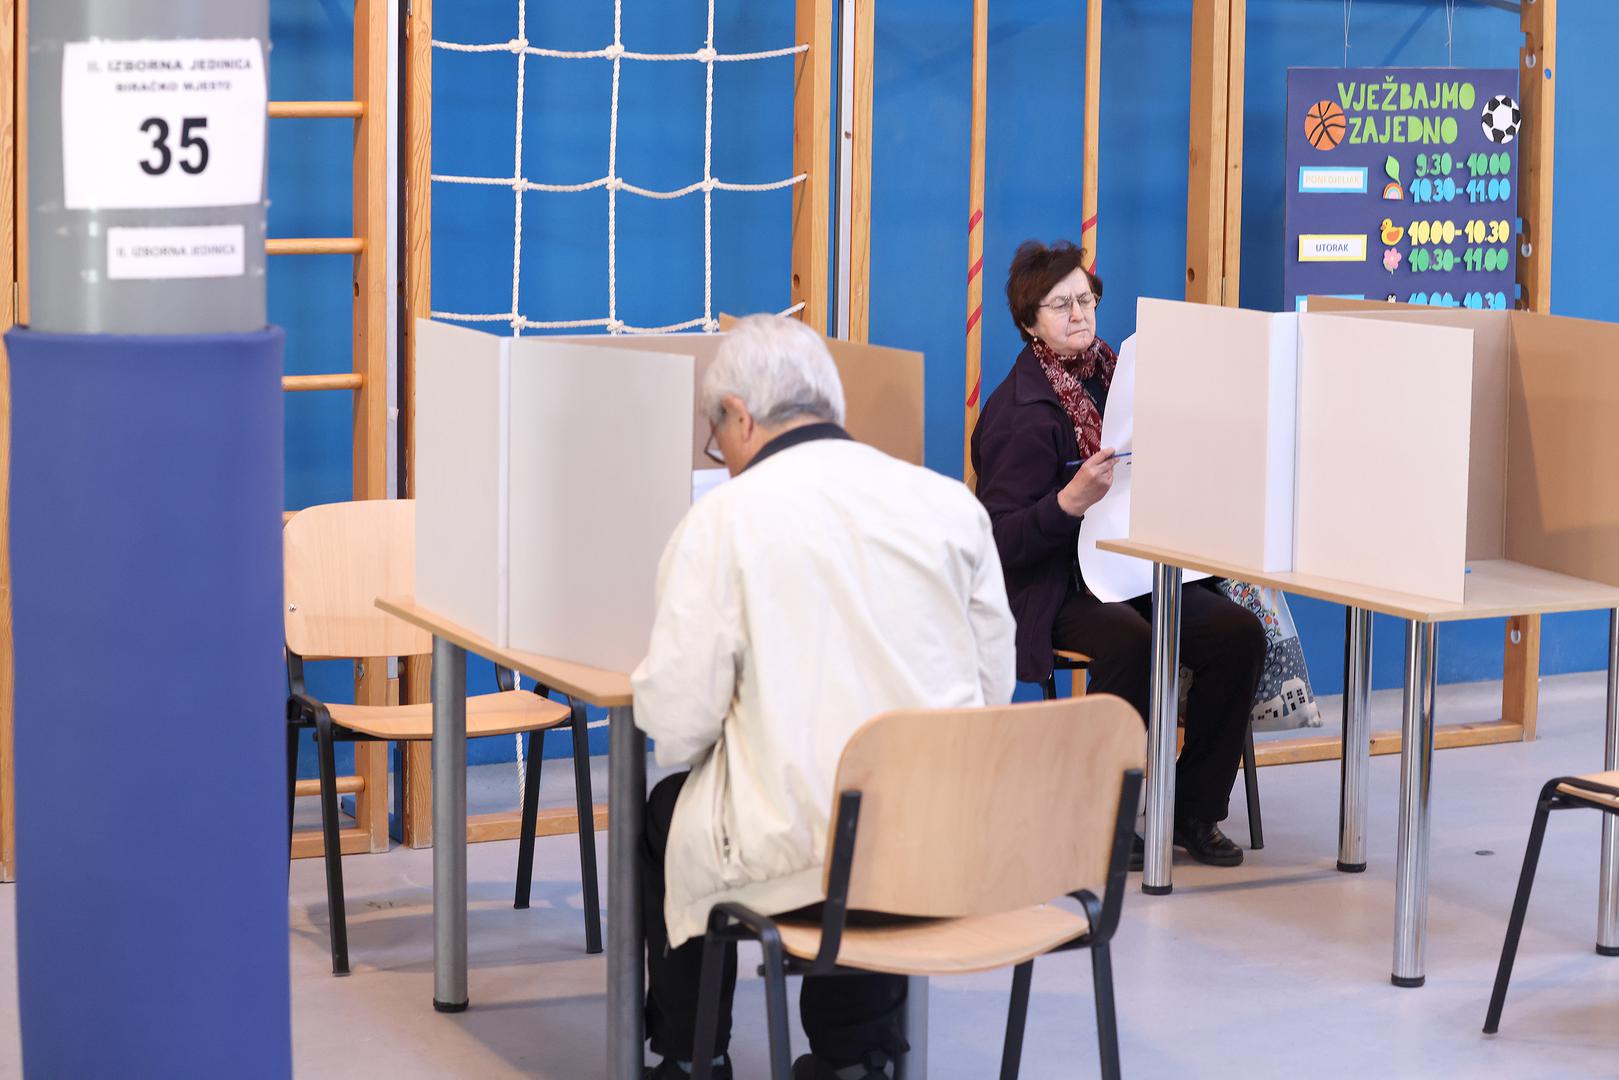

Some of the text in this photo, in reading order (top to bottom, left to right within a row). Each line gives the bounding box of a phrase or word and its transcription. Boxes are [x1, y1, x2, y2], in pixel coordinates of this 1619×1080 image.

[107, 60, 183, 72] IZBORNA
[190, 58, 252, 71] JEDINICA
[1337, 75, 1476, 111] VJEŽBAJMO
[1348, 116, 1458, 145] ZAJEDNO
[139, 117, 209, 175] 35
[1416, 152, 1452, 177] 9.30
[1467, 152, 1511, 177] 10.00
[1410, 177, 1456, 203] 10.30
[1466, 178, 1511, 203] 11.00
[1465, 220, 1510, 244] 10.30
[190, 243, 236, 255] JEDINICA
[1315, 243, 1349, 253] UTORAK
[1408, 248, 1454, 272] 10.30
[1463, 248, 1509, 272] 11.00
